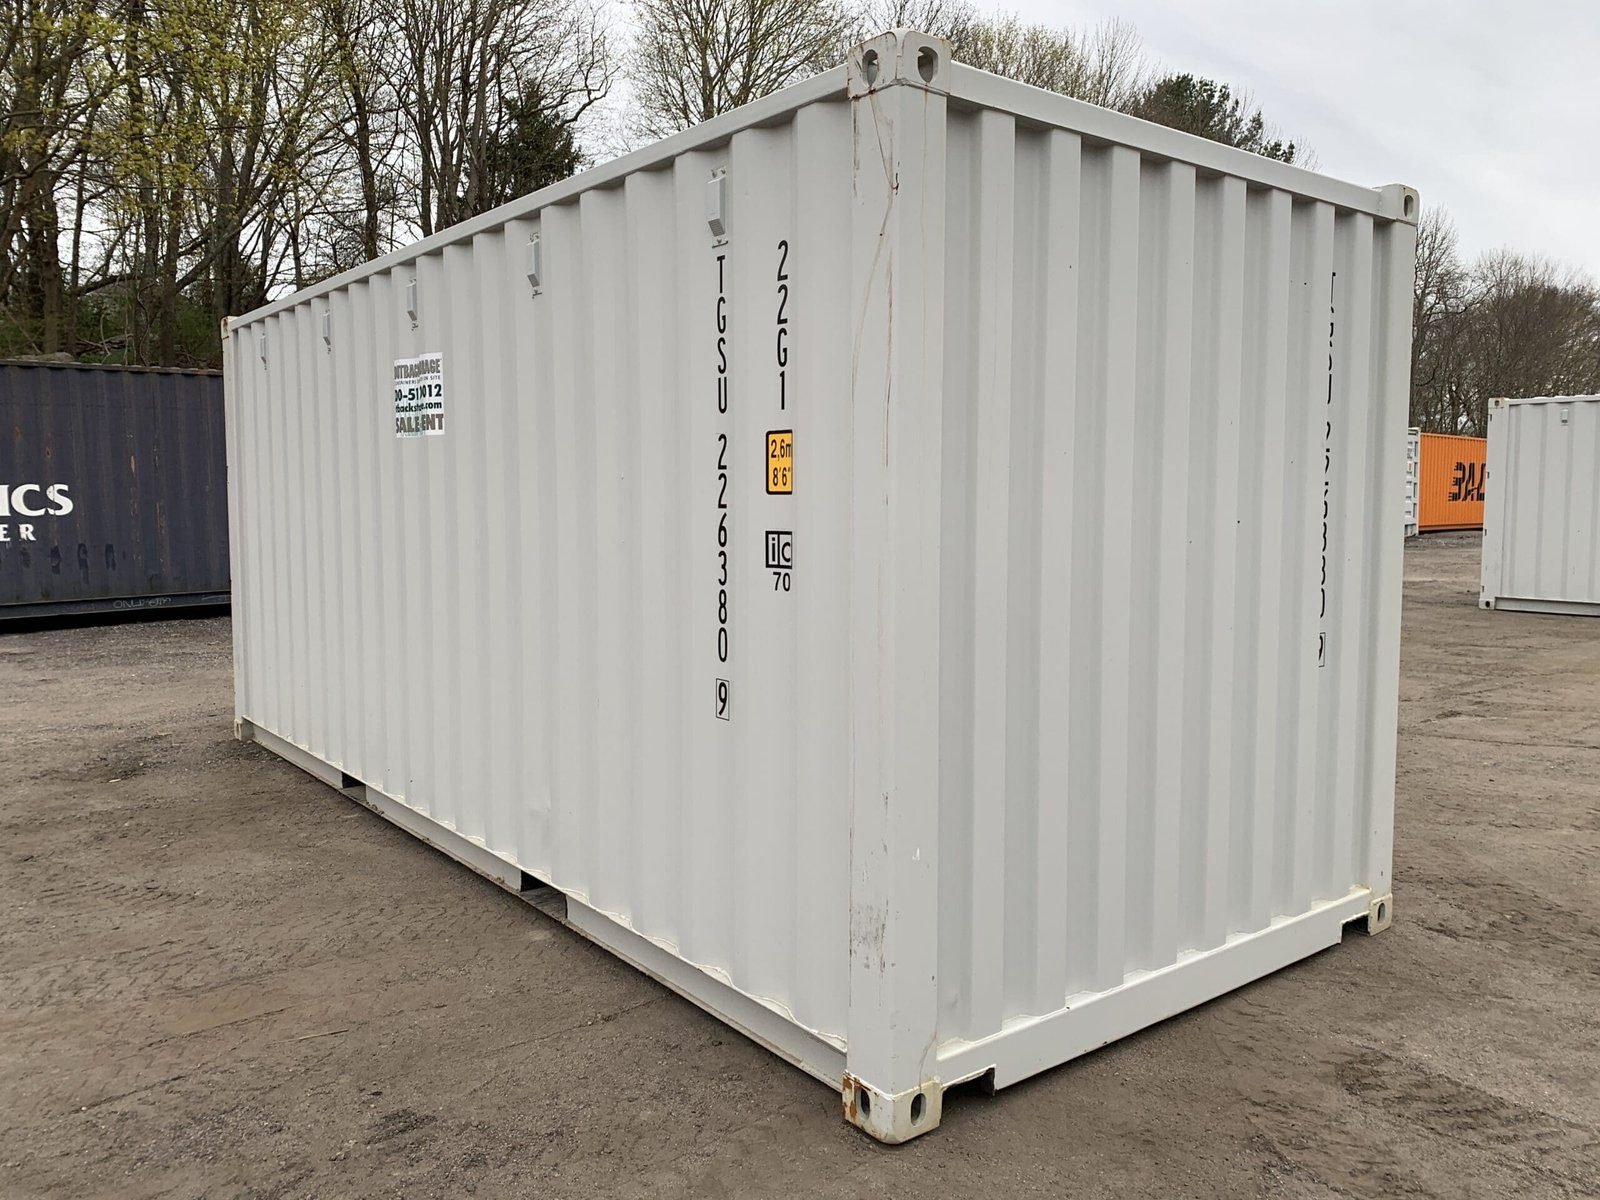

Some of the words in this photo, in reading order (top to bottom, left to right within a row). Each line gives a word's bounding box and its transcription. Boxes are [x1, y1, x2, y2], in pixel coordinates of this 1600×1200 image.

[716, 254, 728, 414] TGSU
[776, 239, 789, 411] 22G1
[717, 433, 728, 663] 226380
[773, 571, 791, 592] 70
[717, 682, 728, 716] 9
